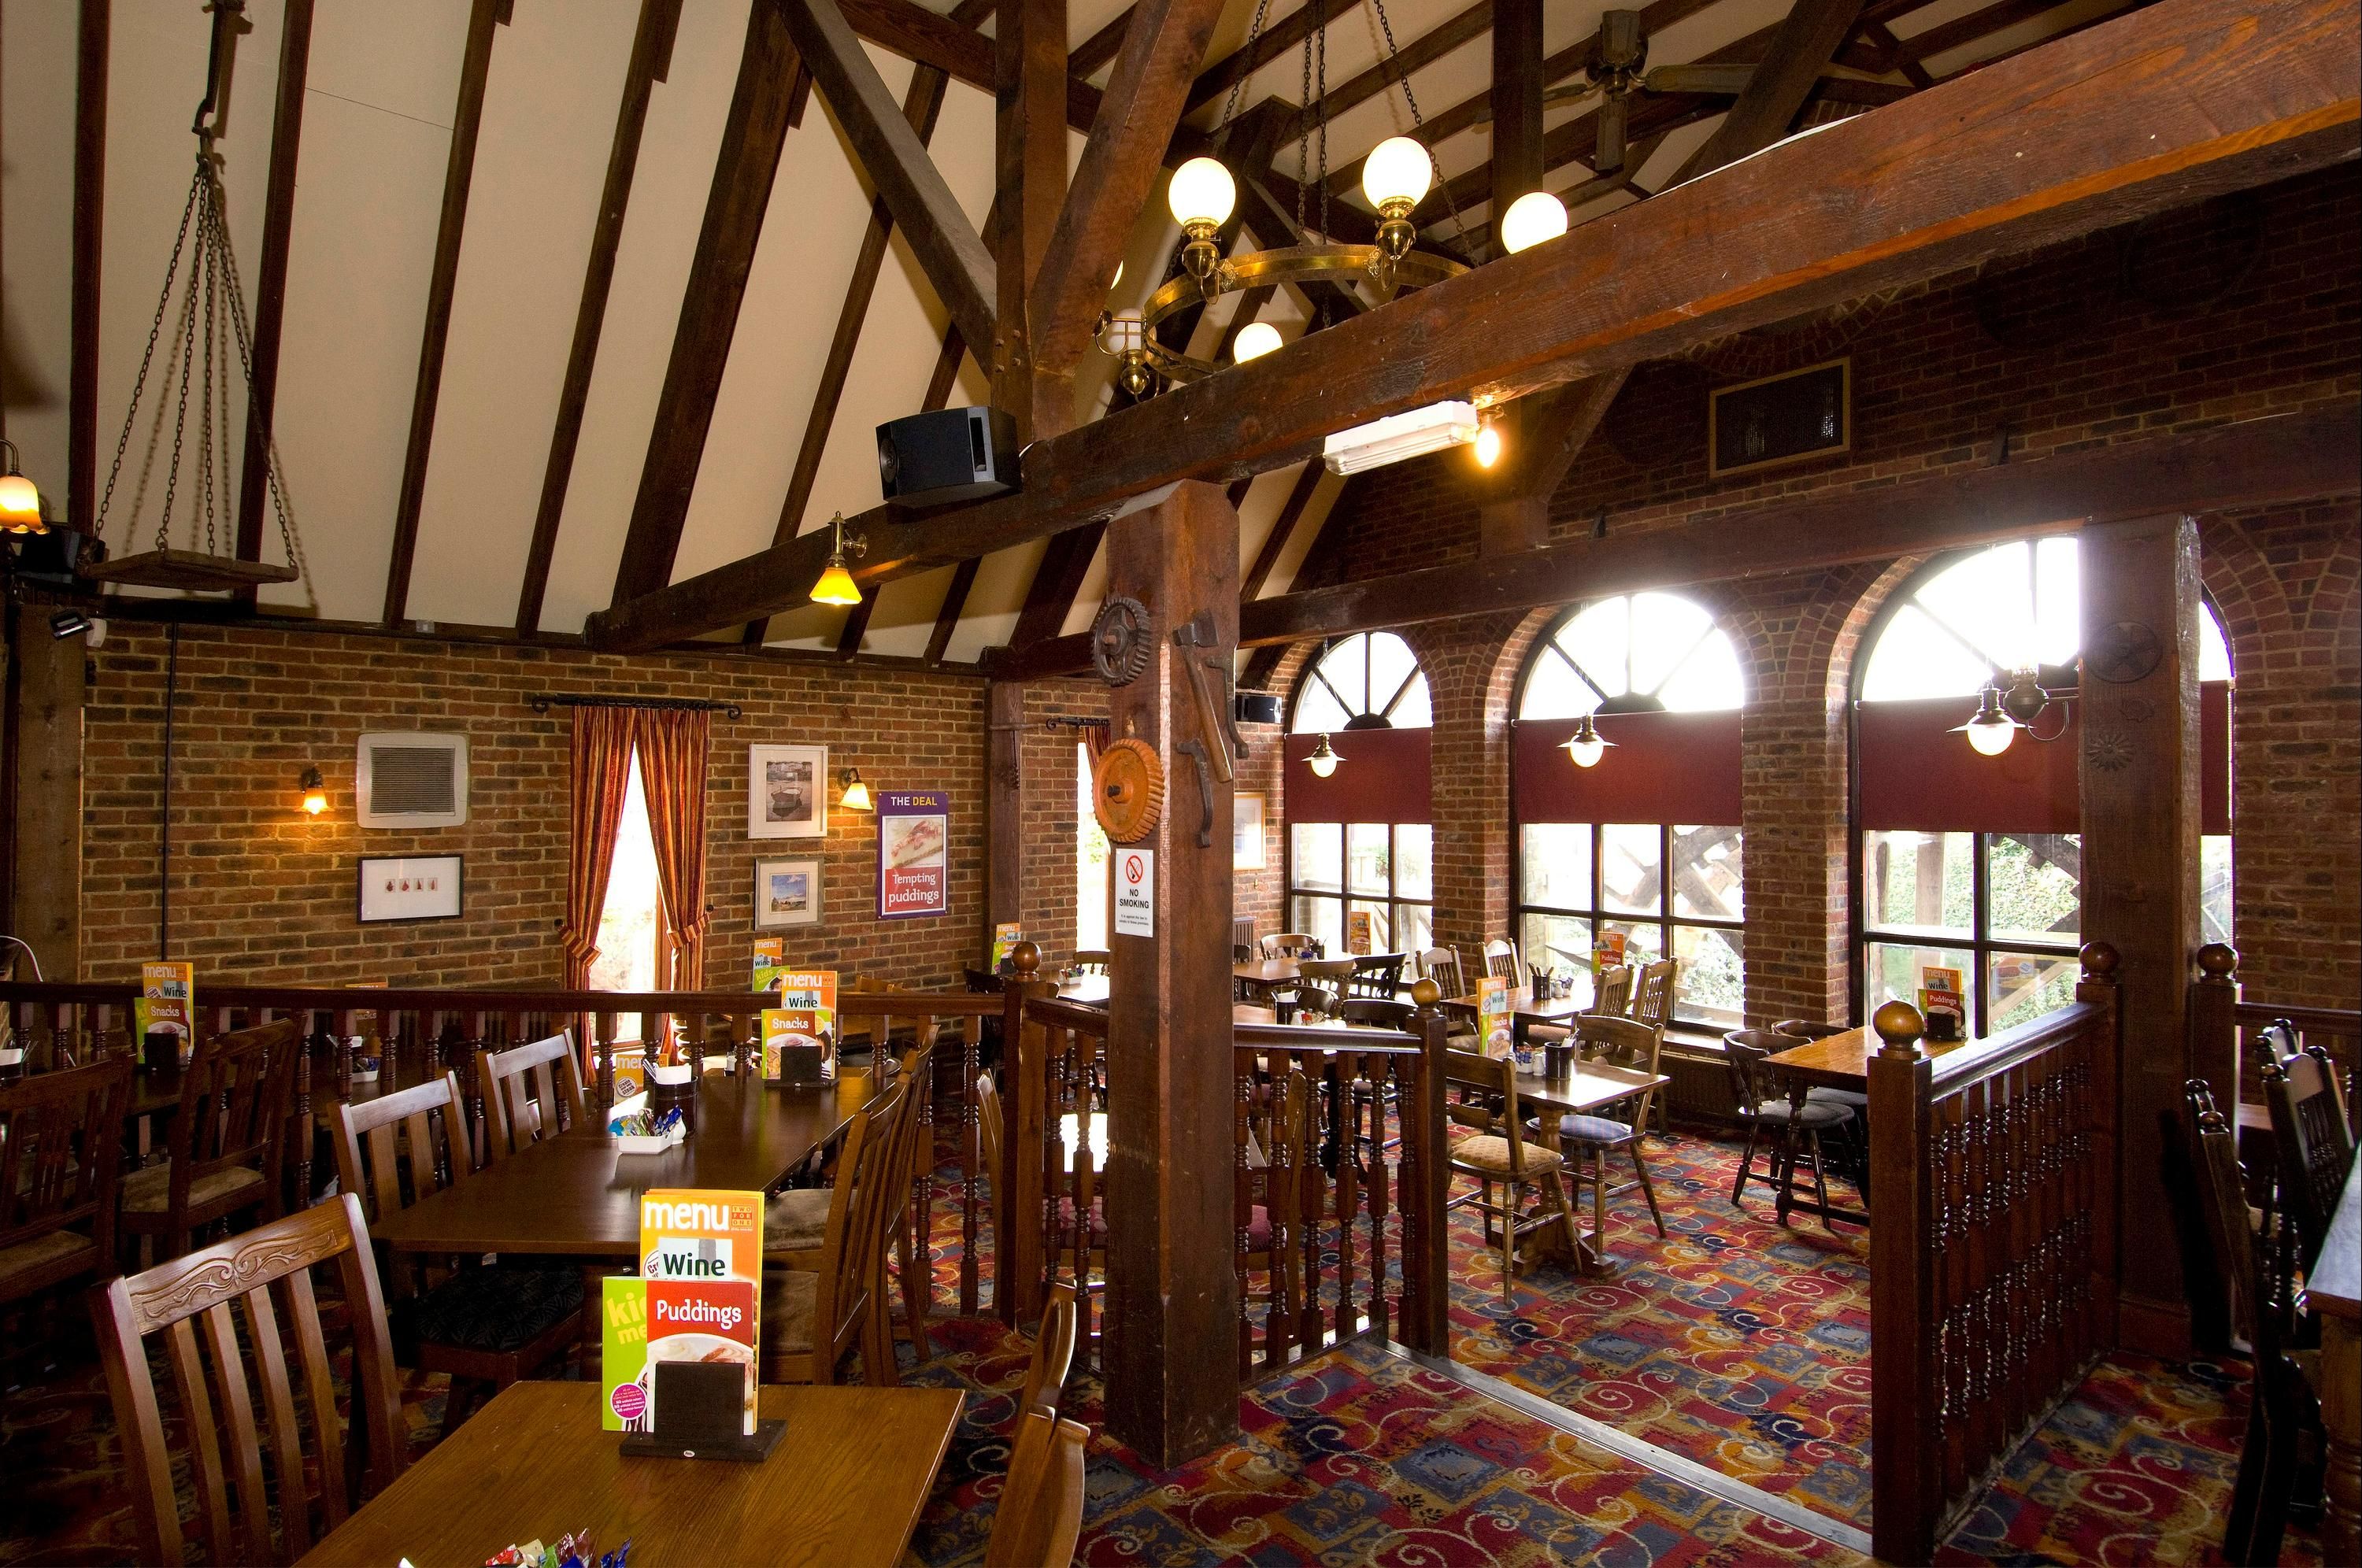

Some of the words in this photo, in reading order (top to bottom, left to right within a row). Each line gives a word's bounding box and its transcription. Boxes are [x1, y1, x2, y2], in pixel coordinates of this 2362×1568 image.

[890, 797, 910, 806] THE
[913, 797, 938, 806] DEAL
[892, 872, 936, 887] Tempting
[888, 888, 939, 907] puddings
[1129, 888, 1139, 897] NO
[1119, 898, 1150, 909] SMOKING
[143, 965, 177, 978] menu
[756, 968, 773, 981] kids
[783, 974, 823, 988] menu
[1483, 980, 1501, 990] menu
[1928, 982, 1949, 990] Wine
[164, 986, 187, 998] Wine
[789, 997, 818, 1008] Wine
[1492, 995, 1506, 1004] Wine
[1930, 995, 1957, 1007] Puddings
[150, 1005, 180, 1017] Snacks
[355, 1011, 377, 1020] nacks
[772, 1016, 809, 1030] Snacks
[616, 1057, 642, 1069] me
[644, 1200, 730, 1231] menu
[663, 1252, 726, 1276] Wine
[606, 1292, 646, 1327] ki
[656, 1299, 742, 1330] Puddings
[617, 1324, 646, 1344] me
